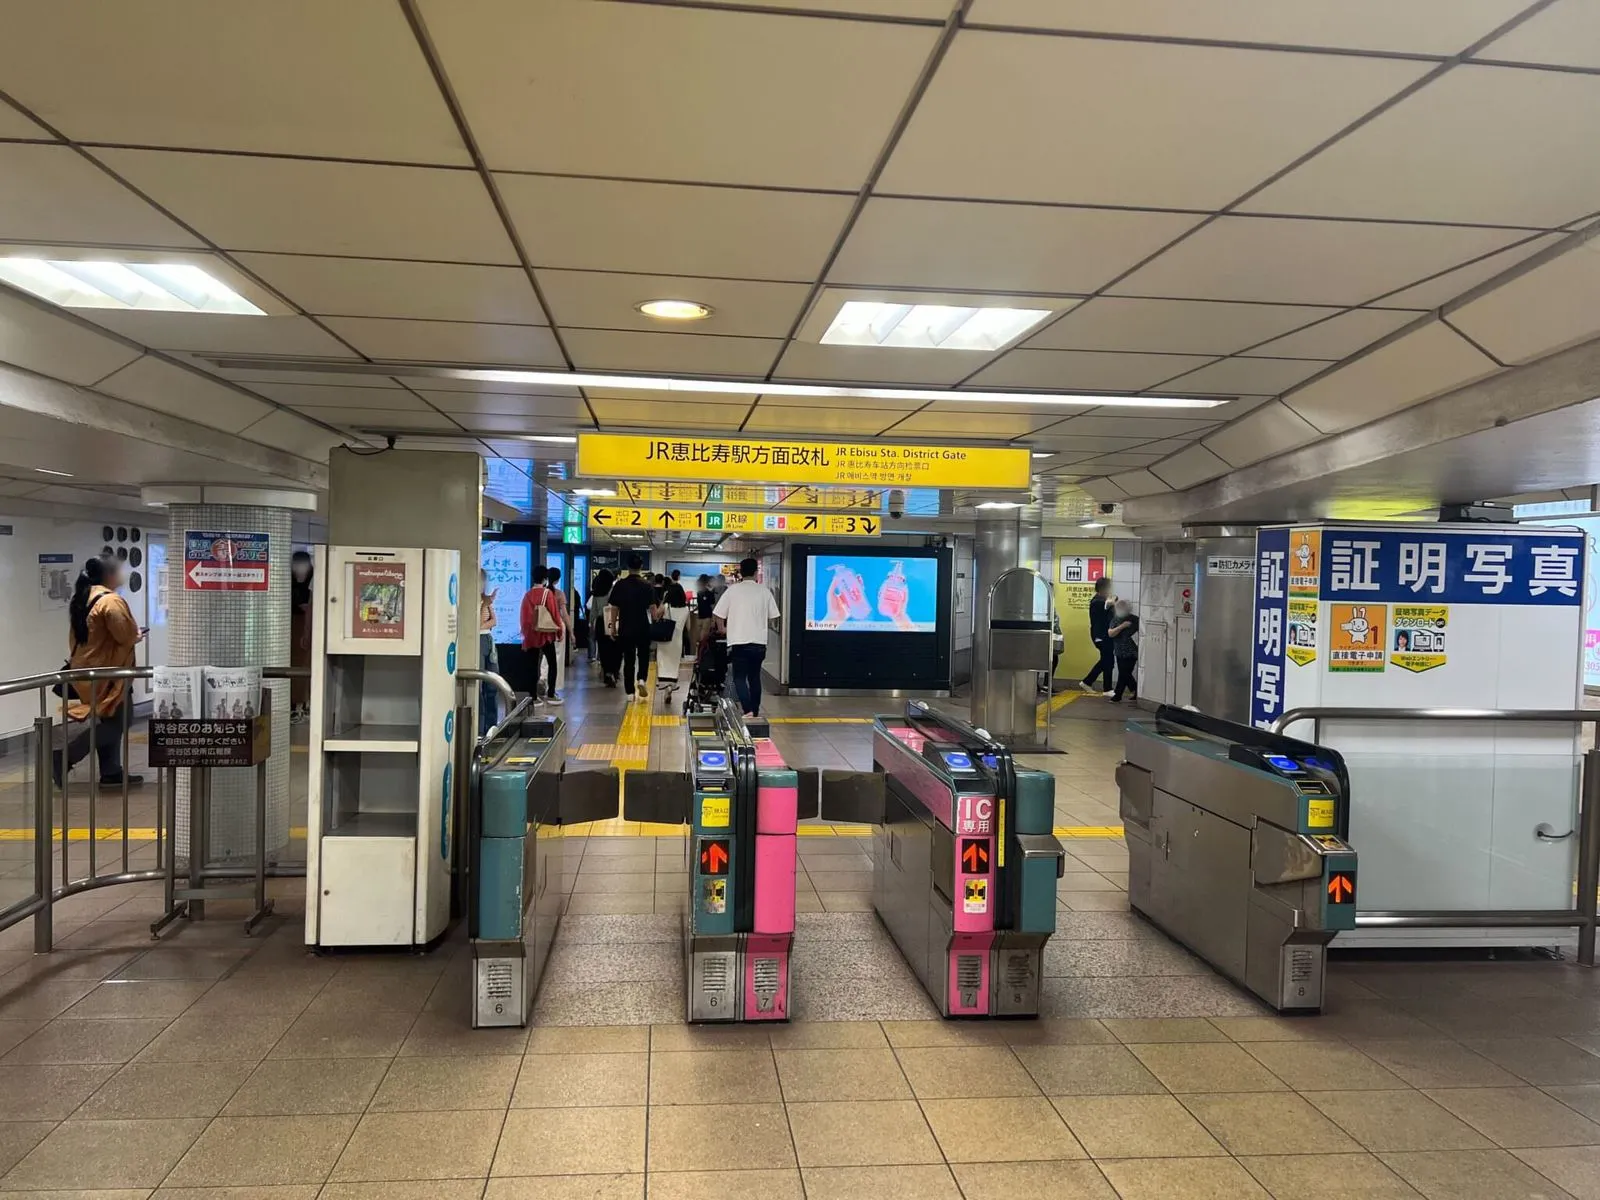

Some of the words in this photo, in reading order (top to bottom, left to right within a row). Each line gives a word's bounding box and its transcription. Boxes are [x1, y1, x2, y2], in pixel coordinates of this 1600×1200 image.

[646, 441, 829, 466] JR恵比寿駅方面改札
[836, 447, 846, 457] JR
[850, 447, 877, 458] Ebisu
[881, 448, 899, 458] Sta.
[903, 449, 939, 459] District
[943, 450, 967, 460] Gate
[631, 510, 641, 526] 2
[695, 513, 702, 527] 1
[708, 516, 721, 526] JR
[846, 517, 855, 532] 3
[1330, 540, 1580, 598] 証明写真
[1395, 607, 1446, 616] 証明写真データ
[154, 722, 247, 734] 渋谷区のお知らせ
[157, 737, 246, 745] ご自由にお持ちください
[966, 799, 992, 820] IC
